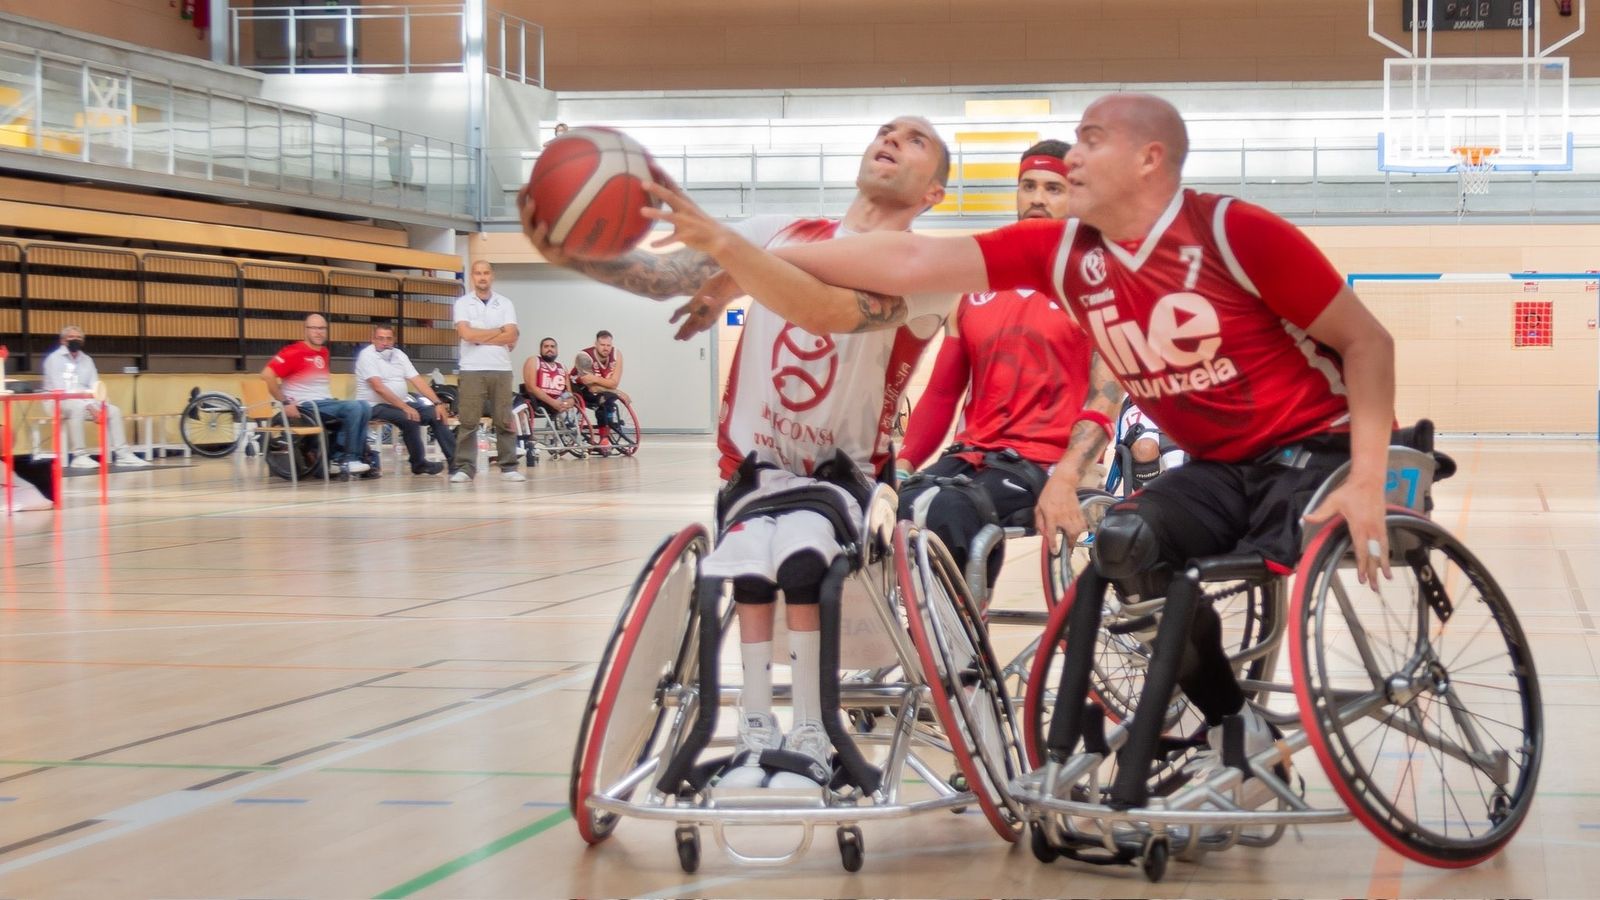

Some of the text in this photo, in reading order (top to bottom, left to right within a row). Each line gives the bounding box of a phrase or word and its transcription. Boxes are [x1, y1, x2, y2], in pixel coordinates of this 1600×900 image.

[1507, 17, 1532, 27] FALTS
[1179, 246, 1203, 290] 7
[1088, 292, 1222, 375] live
